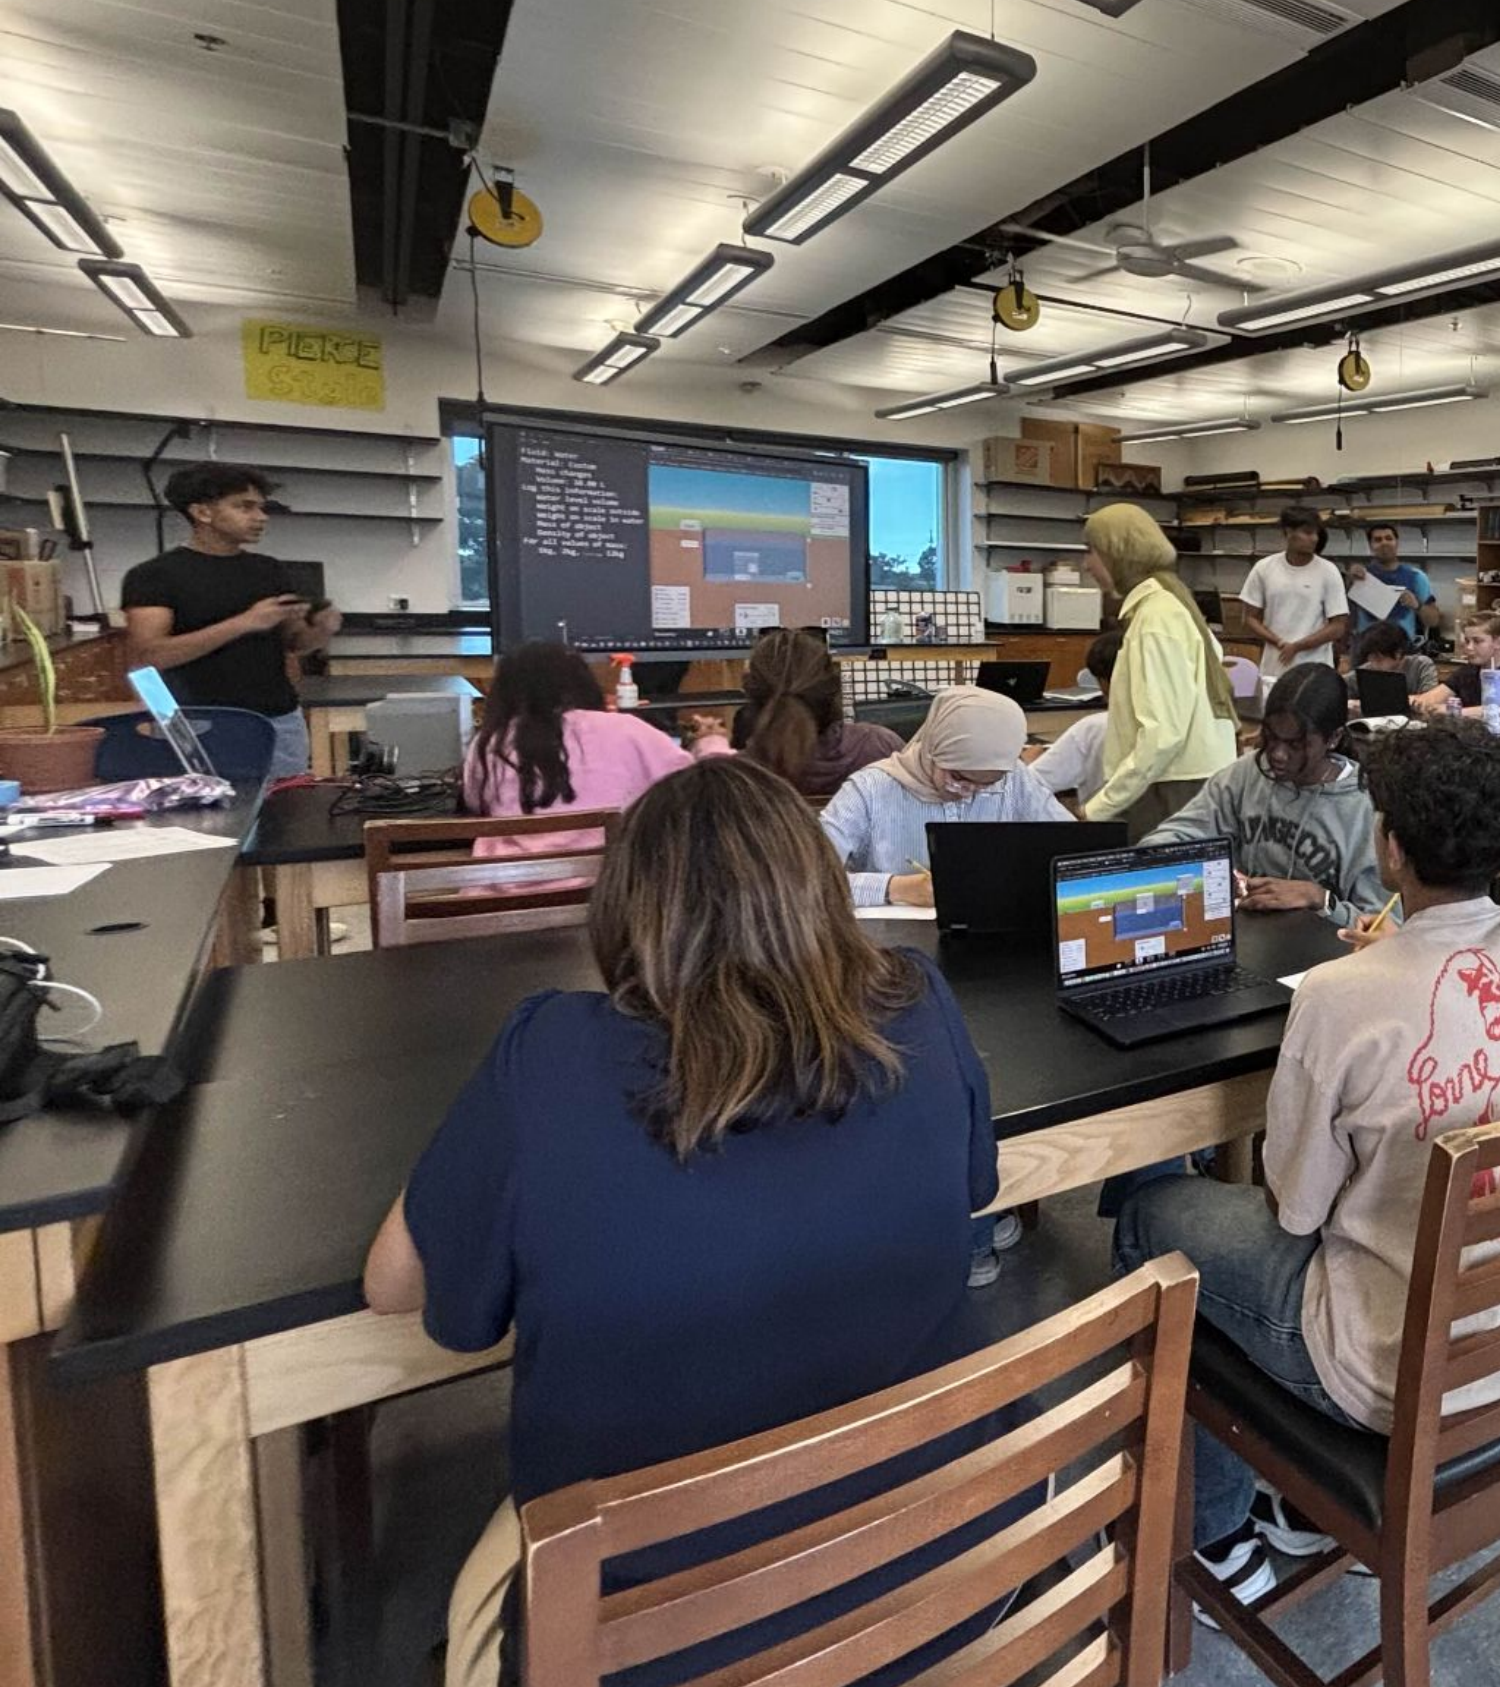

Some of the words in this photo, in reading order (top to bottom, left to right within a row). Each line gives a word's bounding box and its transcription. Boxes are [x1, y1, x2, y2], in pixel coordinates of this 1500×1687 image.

[259, 325, 379, 370] PIERCE
[574, 523, 602, 533] object
[587, 533, 615, 542] object
